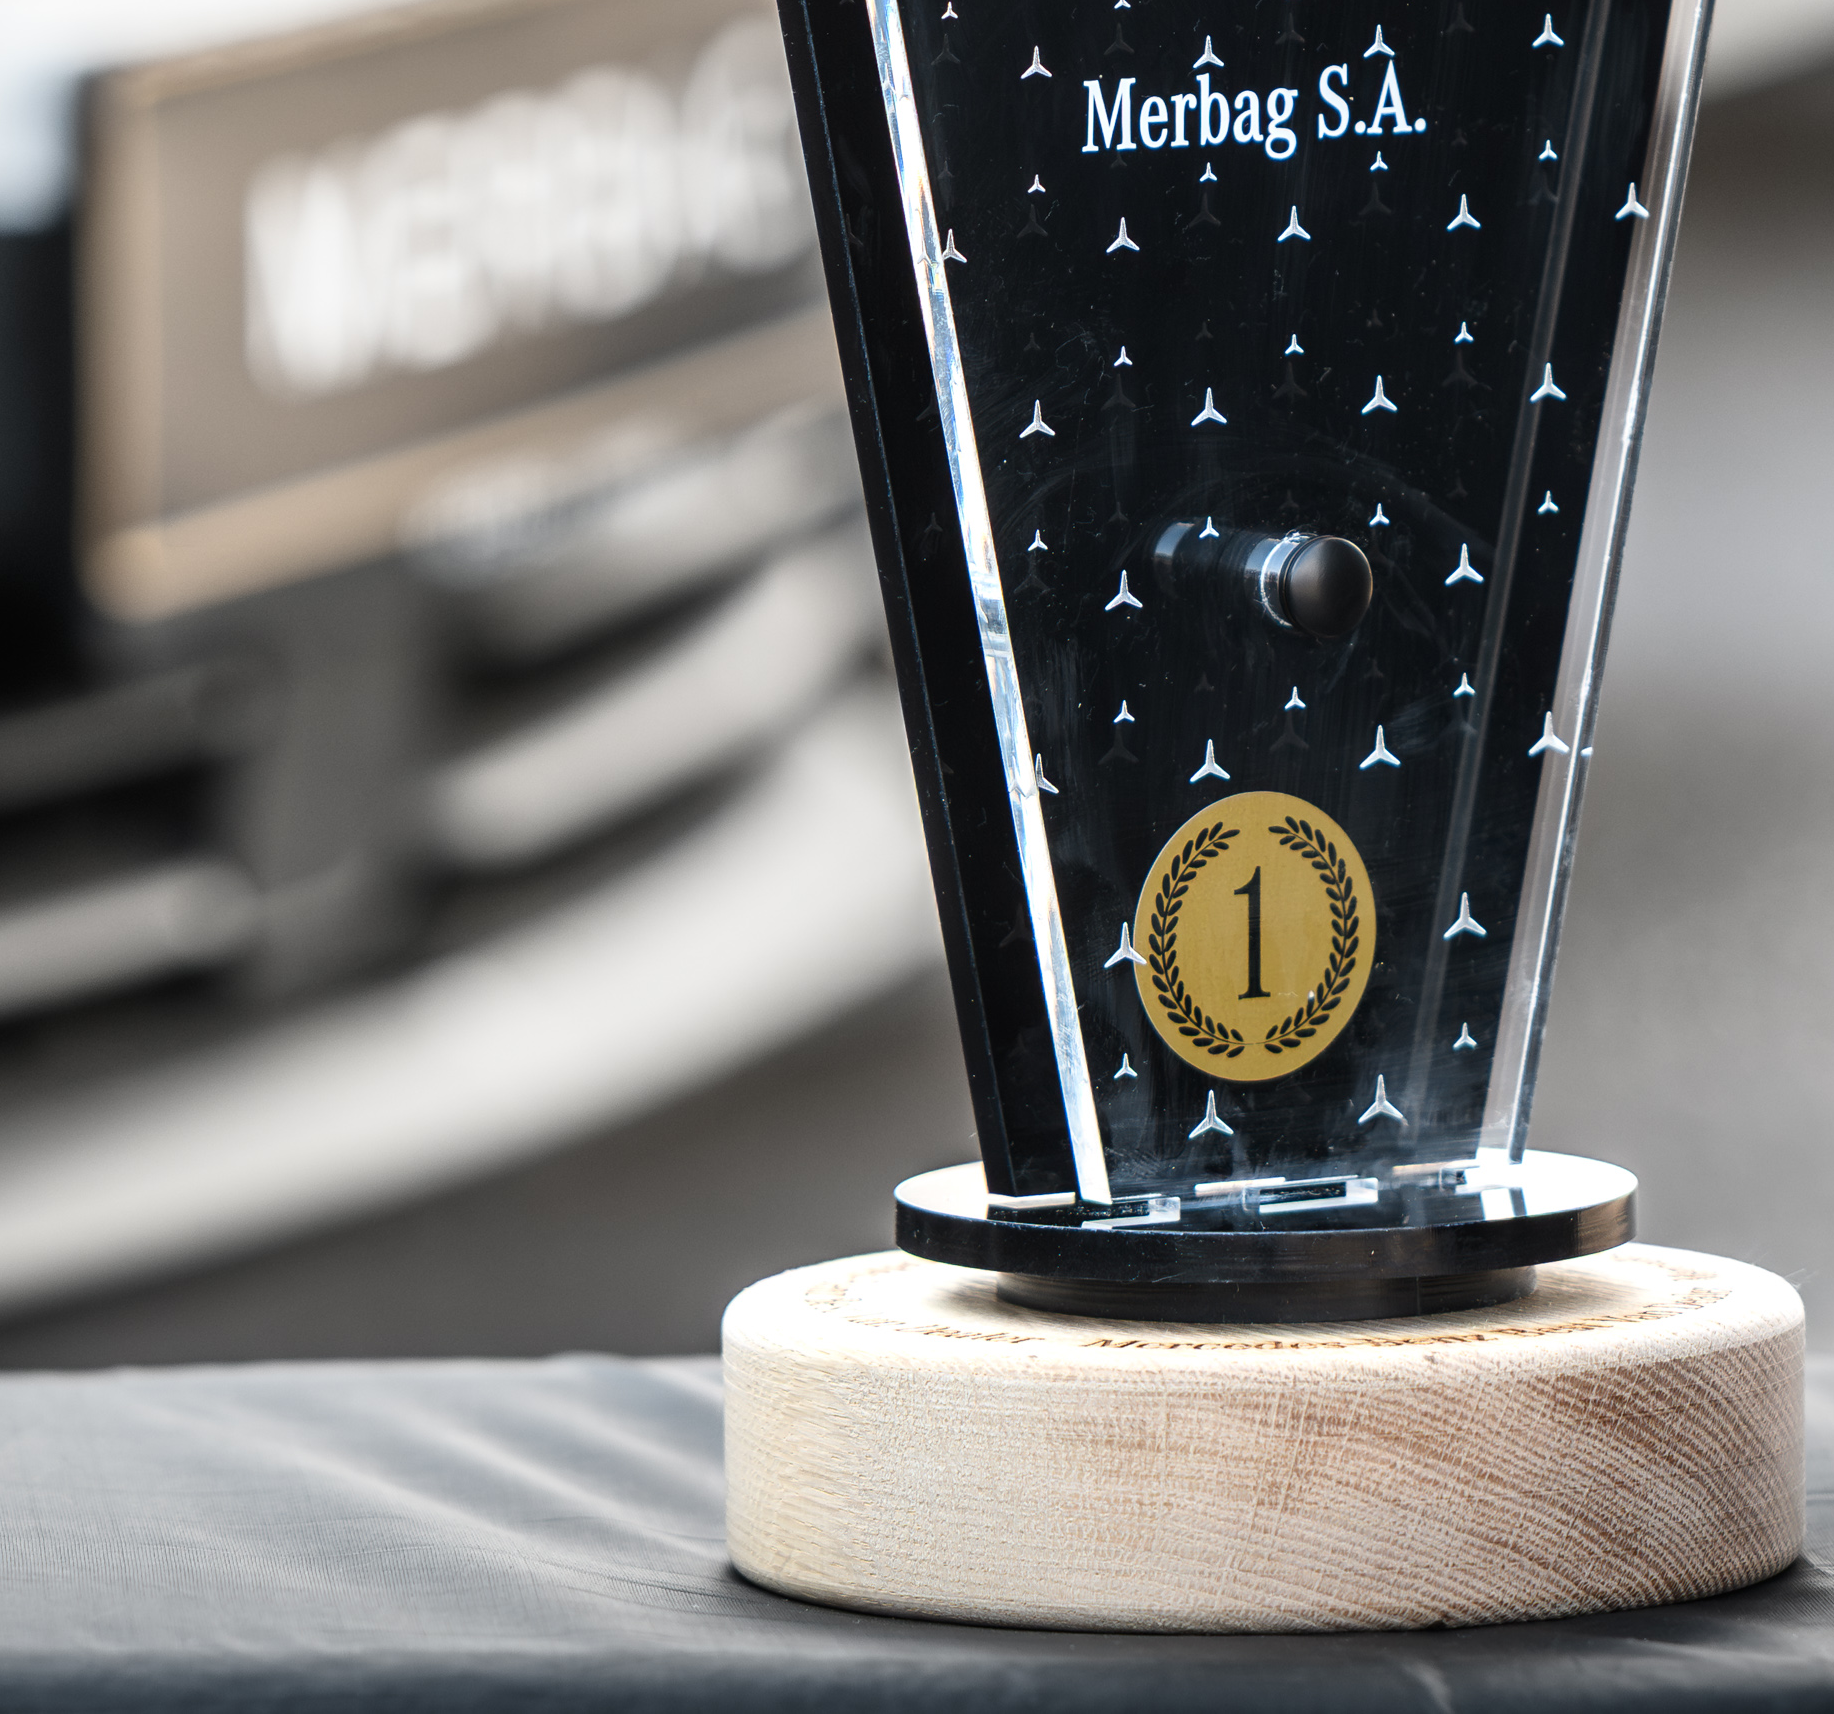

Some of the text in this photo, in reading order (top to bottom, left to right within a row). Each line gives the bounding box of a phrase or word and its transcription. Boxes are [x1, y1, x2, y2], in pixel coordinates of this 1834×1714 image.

[1082, 61, 1426, 159] Merbag S.A.
[1234, 866, 1271, 1000] 1
